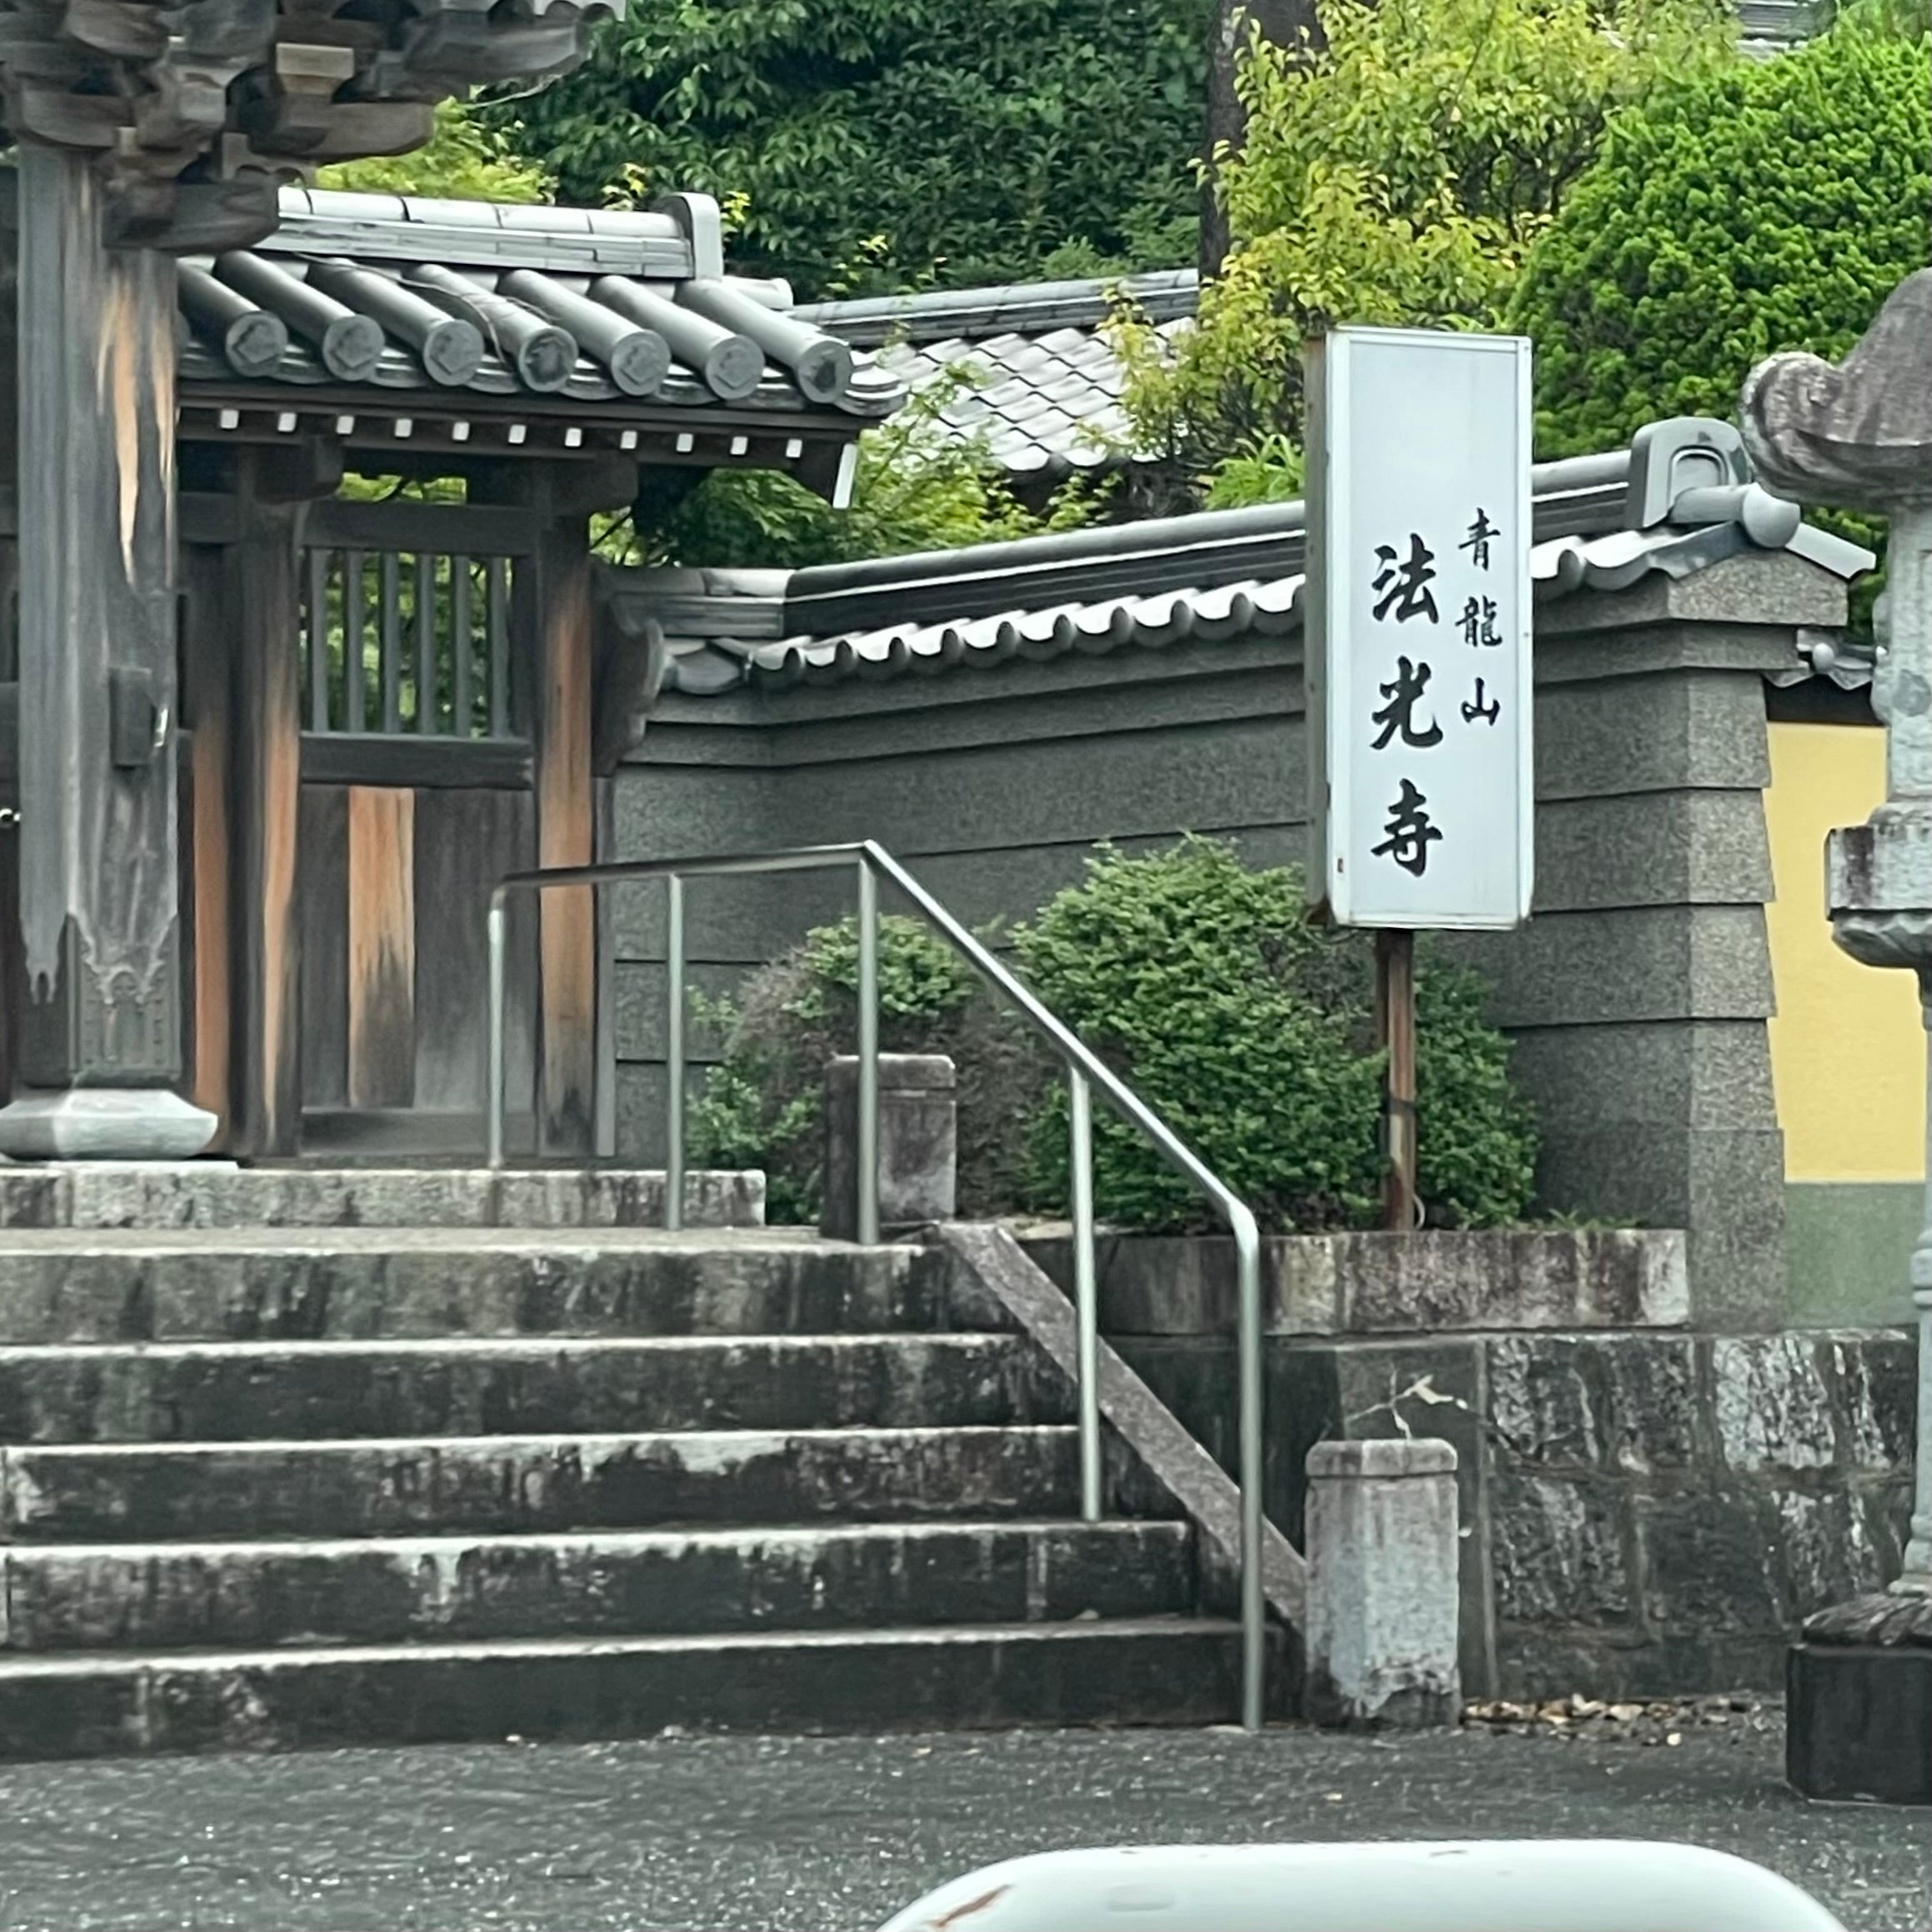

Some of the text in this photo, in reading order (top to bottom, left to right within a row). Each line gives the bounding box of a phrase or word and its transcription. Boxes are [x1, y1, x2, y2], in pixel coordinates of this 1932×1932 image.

[1370, 533, 1444, 877] 法光寺
[1455, 507, 1503, 726] 青龍山
